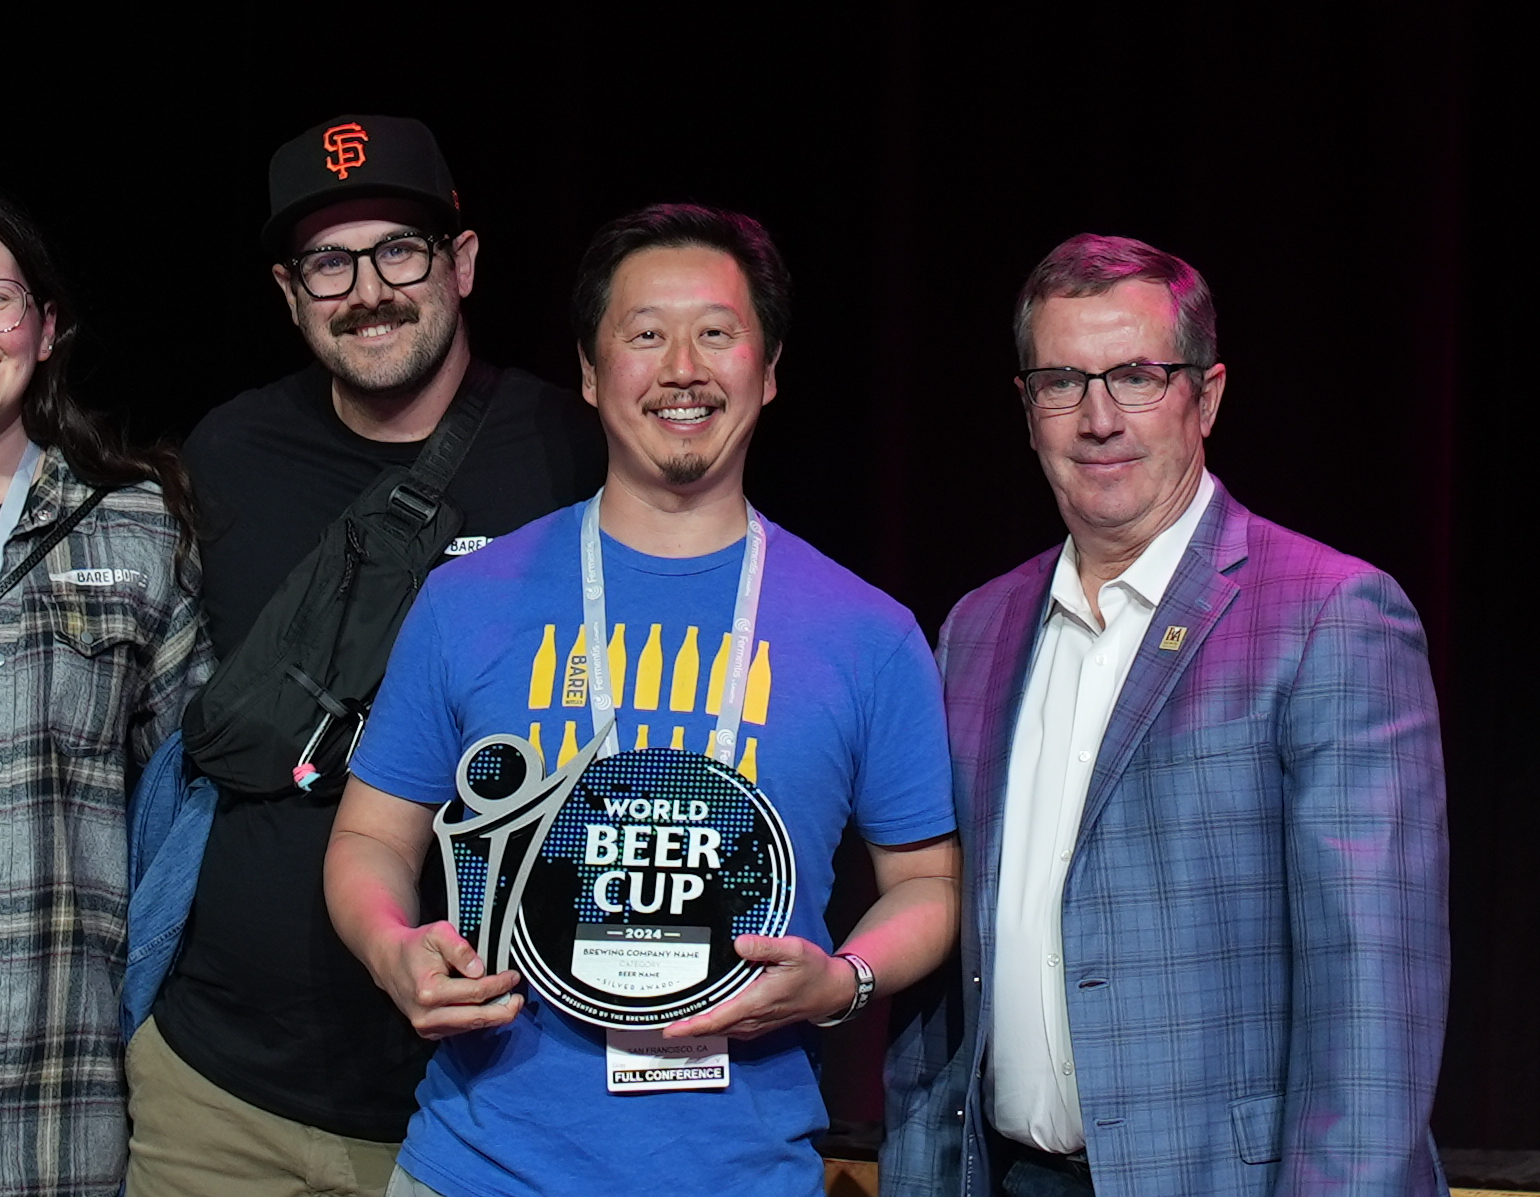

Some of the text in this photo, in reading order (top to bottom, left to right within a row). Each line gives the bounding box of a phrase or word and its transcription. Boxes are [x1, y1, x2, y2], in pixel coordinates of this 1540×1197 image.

[451, 540, 483, 552] BARE
[77, 571, 110, 582] BARE
[732, 635, 748, 678] Fermentis
[567, 655, 587, 698] BARE
[590, 645, 603, 691] Fermentis
[603, 798, 709, 821] WORLD
[584, 824, 721, 868] BEER
[593, 871, 705, 915] CUP
[625, 928, 662, 940] 2024
[583, 948, 700, 959] BREWING COMPANY NAME
[619, 960, 660, 968] CATEGORY
[603, 978, 674, 990] SILVER AWARD
[561, 994, 708, 1022] PRESENTED BY THE BREWERS ASSOCIATION
[614, 1068, 722, 1082] FULL CONFERENCE
